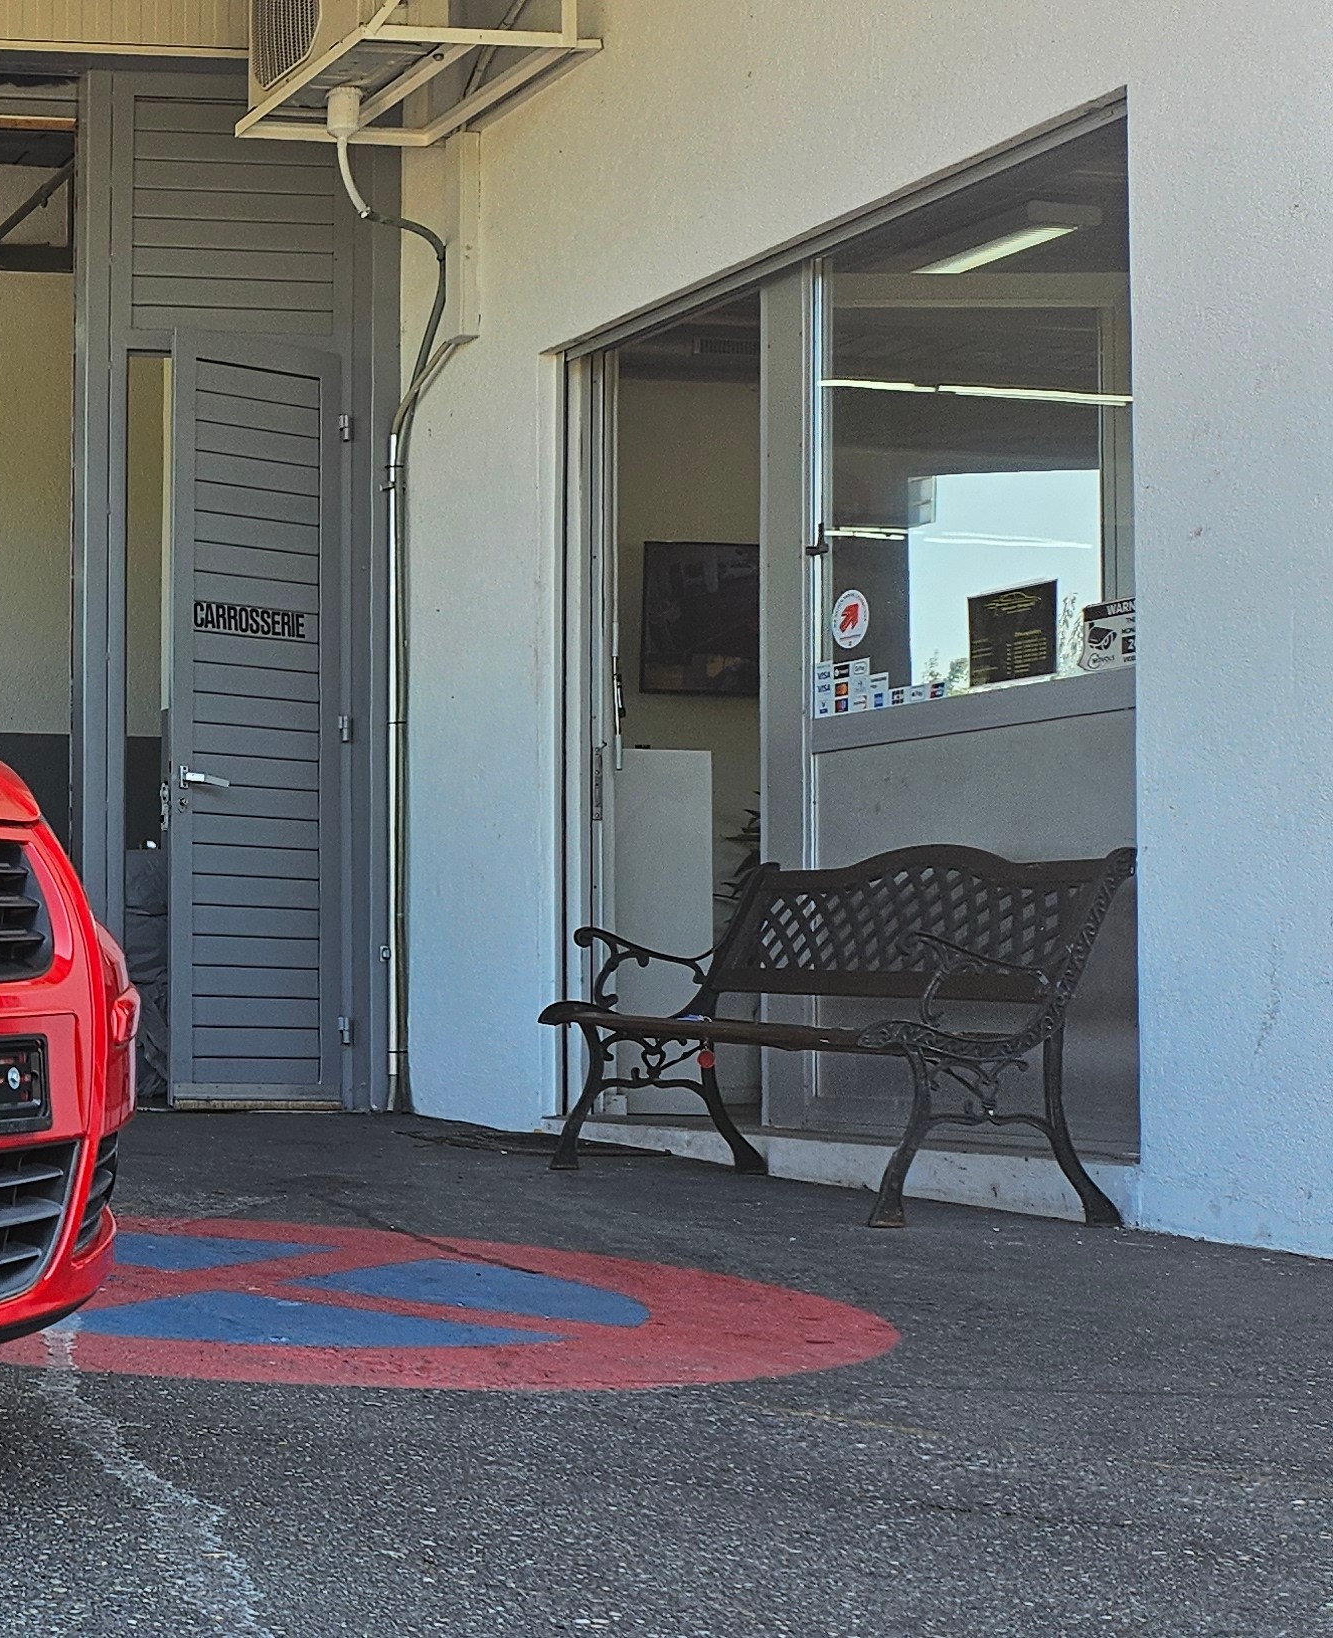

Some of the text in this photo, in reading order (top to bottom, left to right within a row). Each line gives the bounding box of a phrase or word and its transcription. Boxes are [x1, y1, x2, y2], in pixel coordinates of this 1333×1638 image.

[193, 602, 306, 638] CARROSSERIE
[817, 671, 831, 680] VISA
[817, 684, 831, 692] VISA
